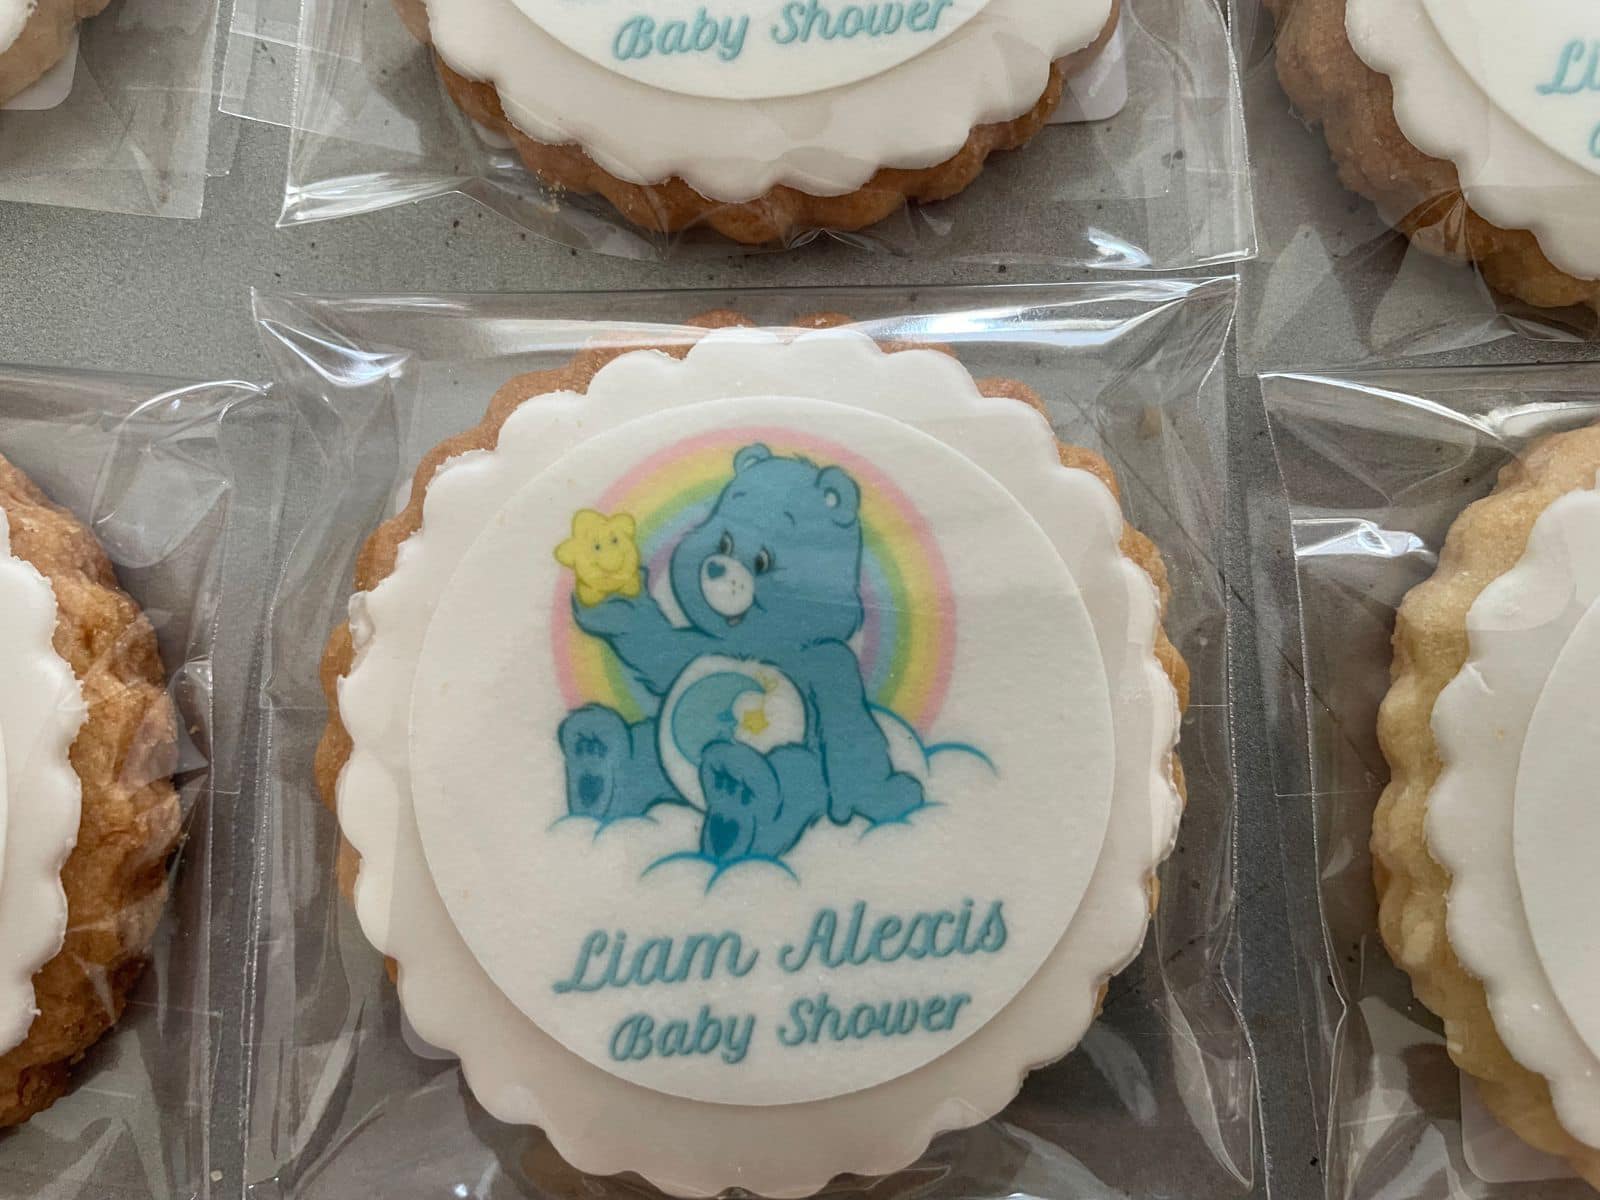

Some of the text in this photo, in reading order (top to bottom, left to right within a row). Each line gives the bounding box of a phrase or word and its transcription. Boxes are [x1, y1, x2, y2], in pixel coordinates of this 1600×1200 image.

[613, 0, 954, 61] Baby Shower
[553, 899, 1008, 994] Liam Alexis
[610, 993, 971, 1064] Baby Shower
